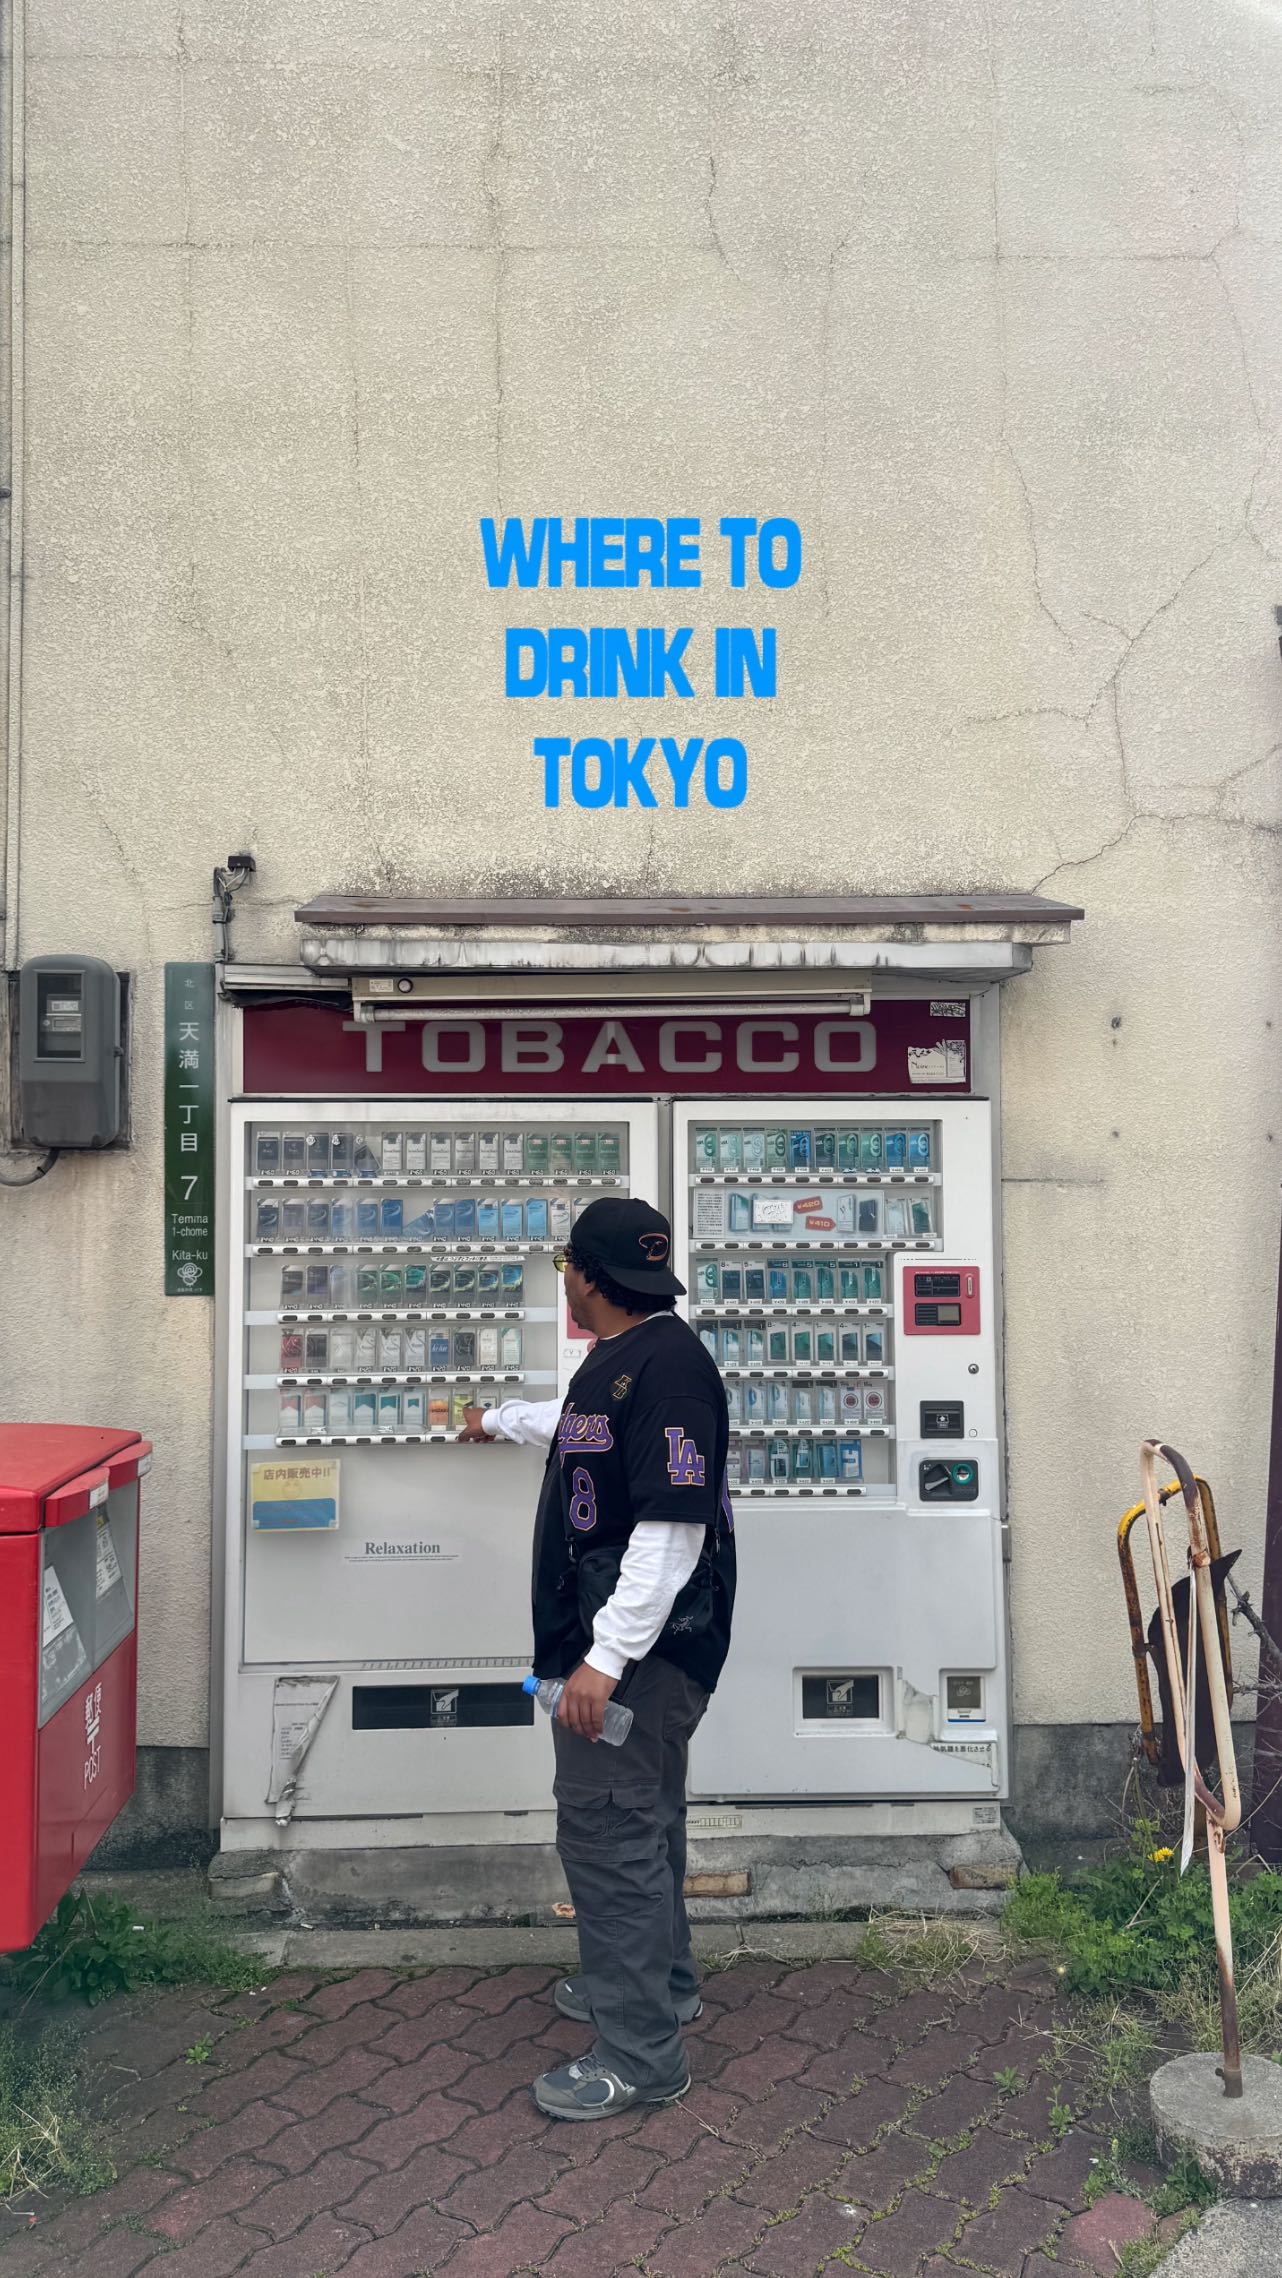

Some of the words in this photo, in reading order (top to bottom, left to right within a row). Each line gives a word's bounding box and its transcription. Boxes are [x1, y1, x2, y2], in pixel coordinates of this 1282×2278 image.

[342, 1020, 877, 1073] TOBACCO
[180, 1176, 198, 1200] 7
[172, 1226, 208, 1237] 1-chome
[172, 1249, 208, 1261] Kita-ku
[664, 1427, 705, 1487] LA
[569, 1466, 597, 1532] 8
[365, 1541, 441, 1555] Relaxation
[84, 1744, 102, 1791] POST
